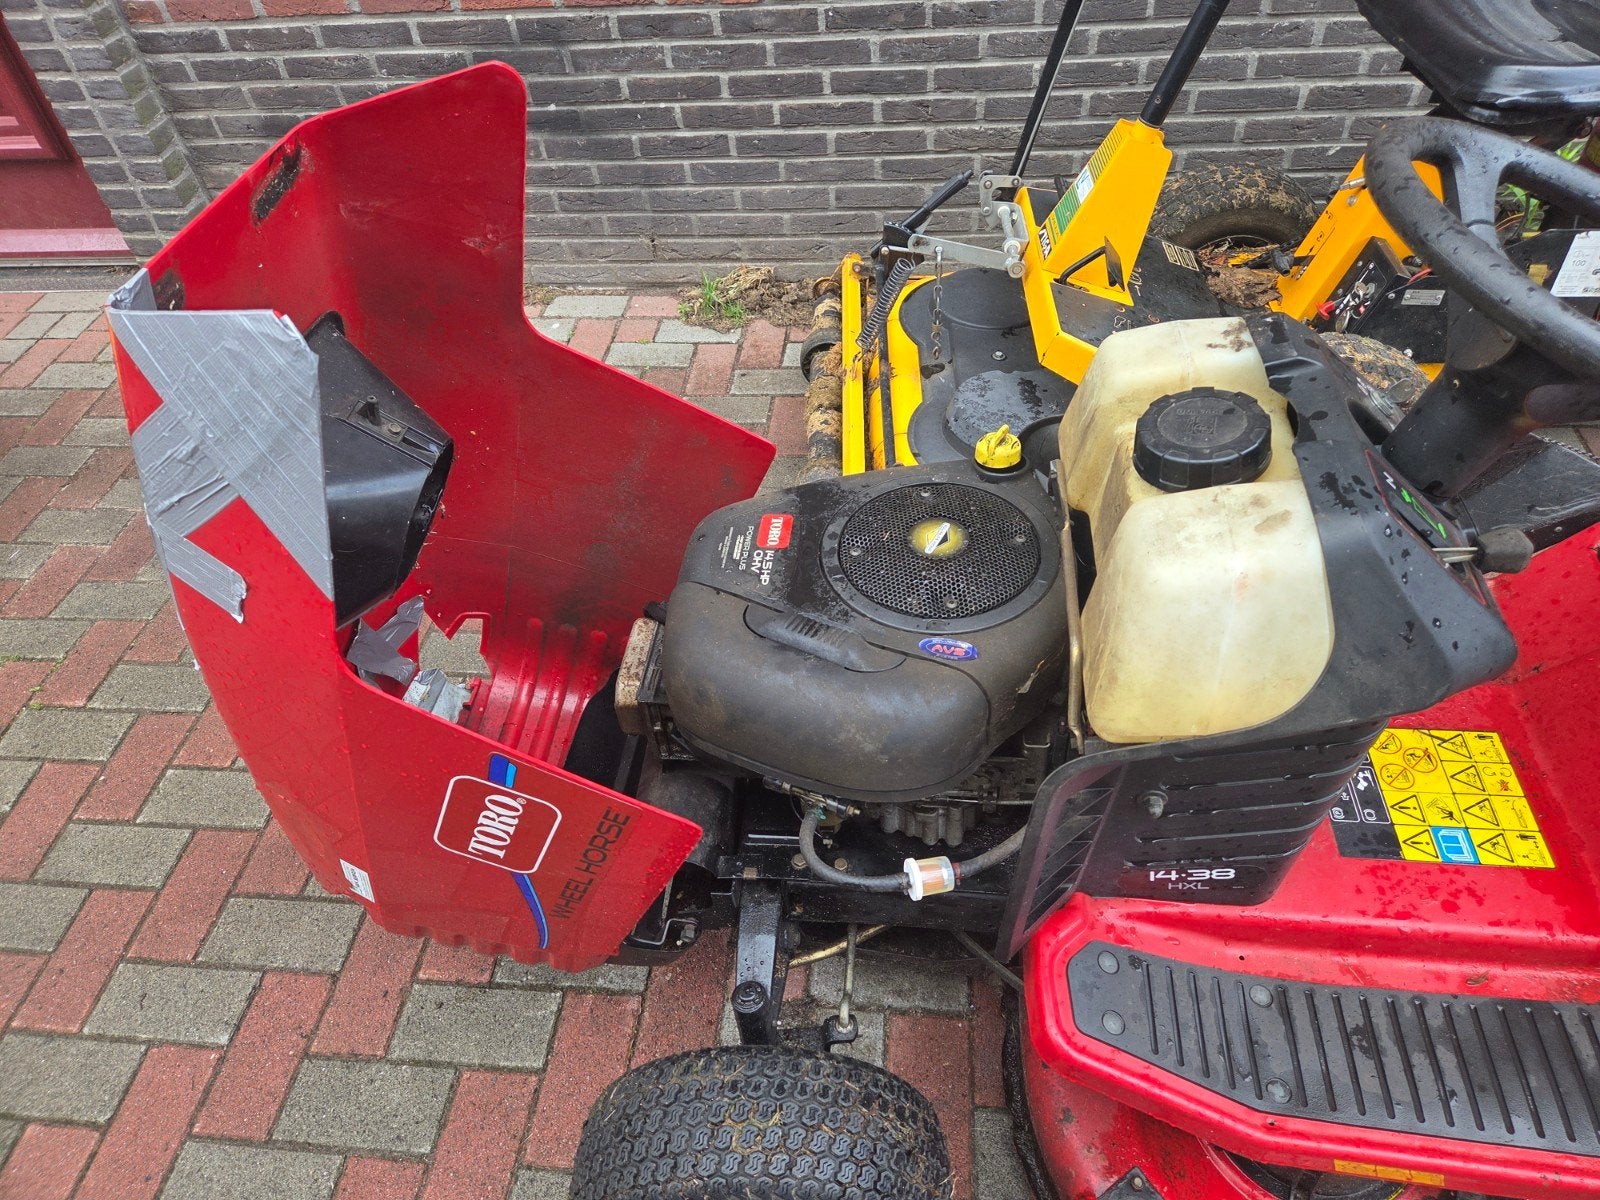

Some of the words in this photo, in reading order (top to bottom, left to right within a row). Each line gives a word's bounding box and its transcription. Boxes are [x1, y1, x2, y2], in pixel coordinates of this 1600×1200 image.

[742, 525, 755, 551] POWER
[767, 516, 784, 546] TORO
[738, 551, 749, 571] PLUS
[750, 550, 764, 574] OHV
[931, 644, 966, 657] AVS
[467, 794, 524, 859] TORO
[550, 877, 594, 919] WHEEL
[575, 807, 630, 876] HORSE
[1168, 882, 1210, 890] HXL
